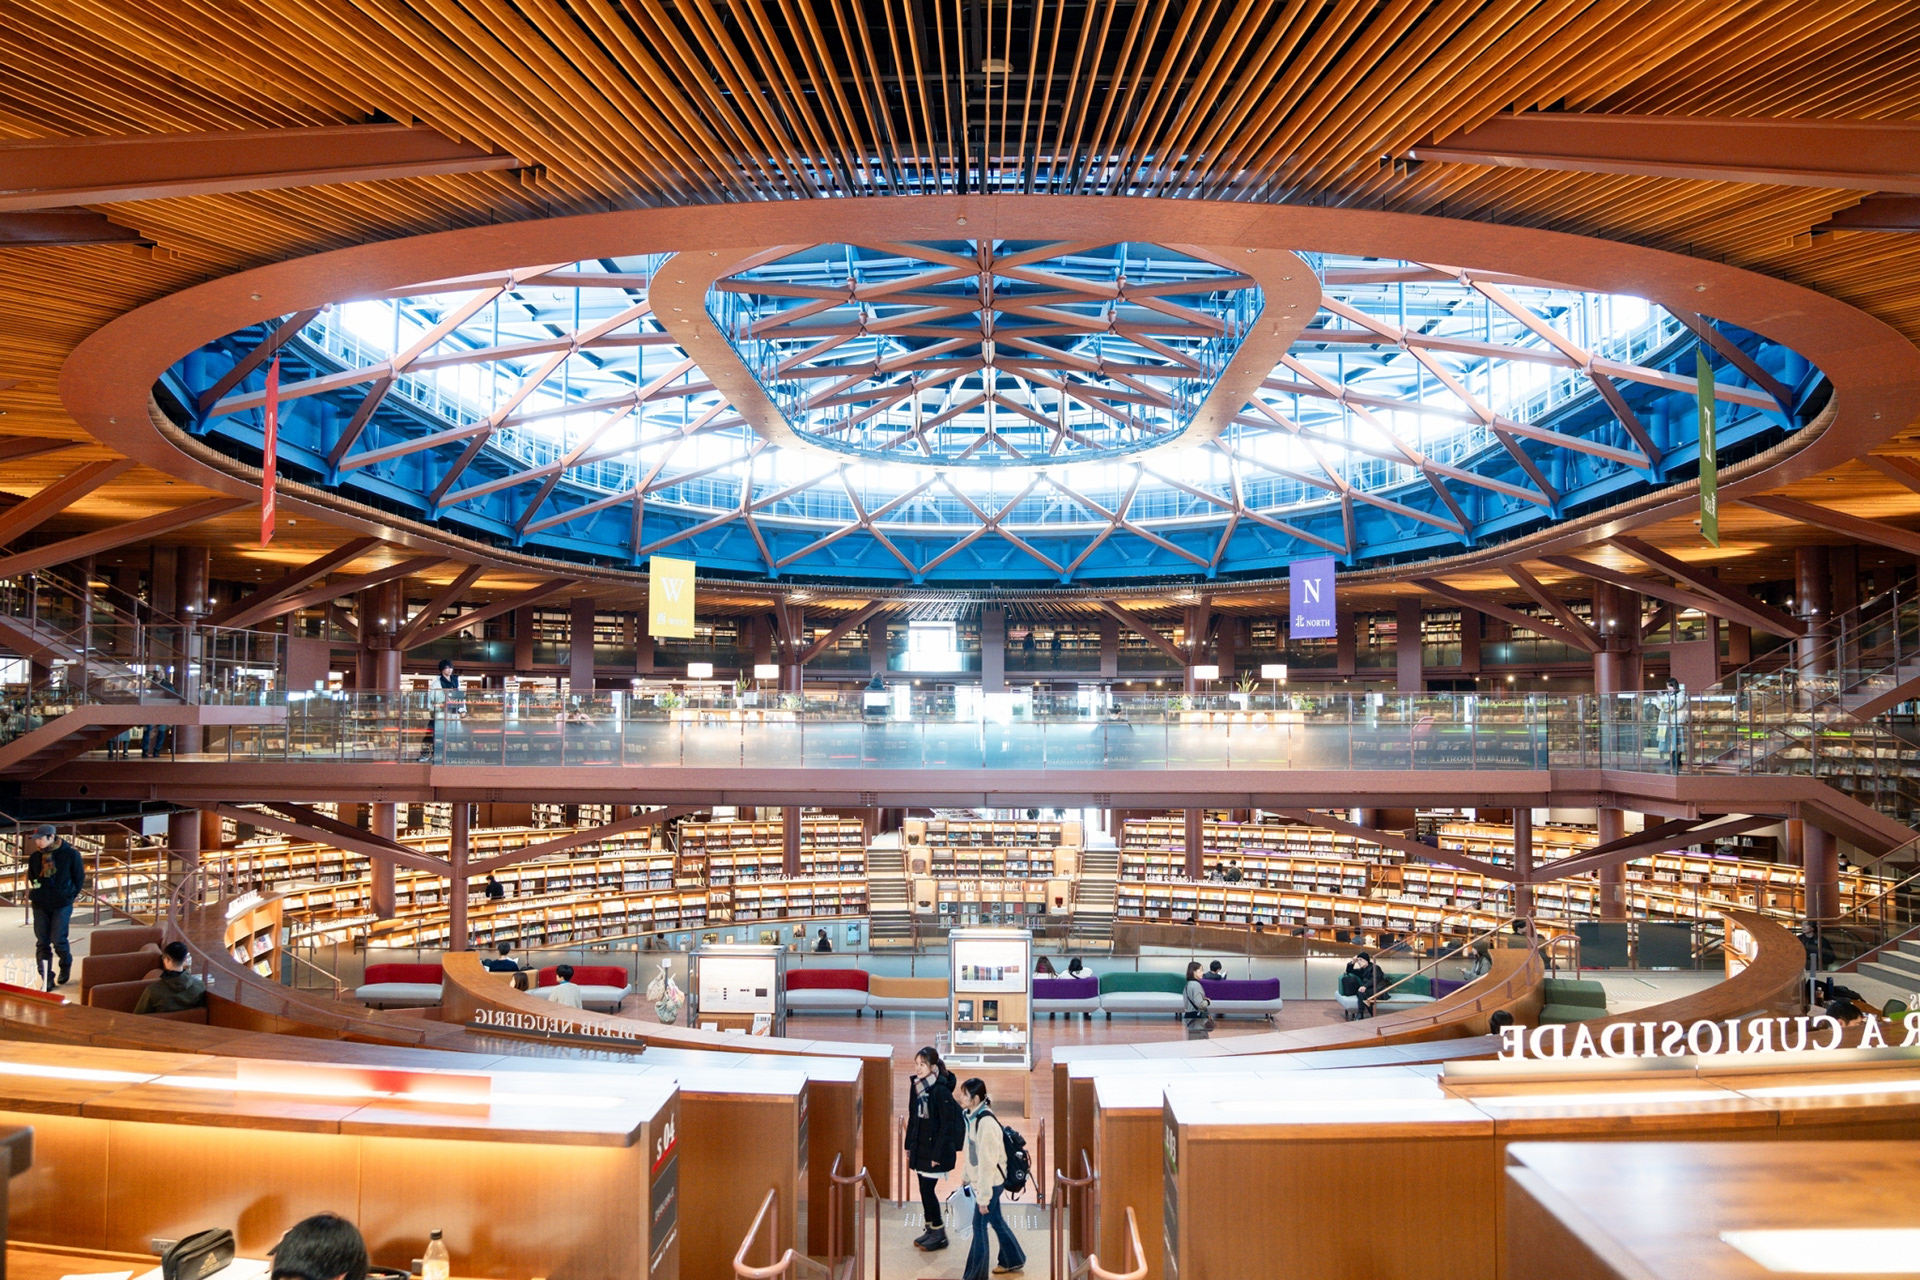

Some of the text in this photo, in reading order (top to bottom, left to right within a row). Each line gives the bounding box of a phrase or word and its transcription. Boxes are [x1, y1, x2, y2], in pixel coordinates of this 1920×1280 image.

[660, 577, 686, 602] W
[1303, 578, 1321, 604] N
[1295, 614, 1304, 627] 北
[1306, 619, 1330, 627] NORTH
